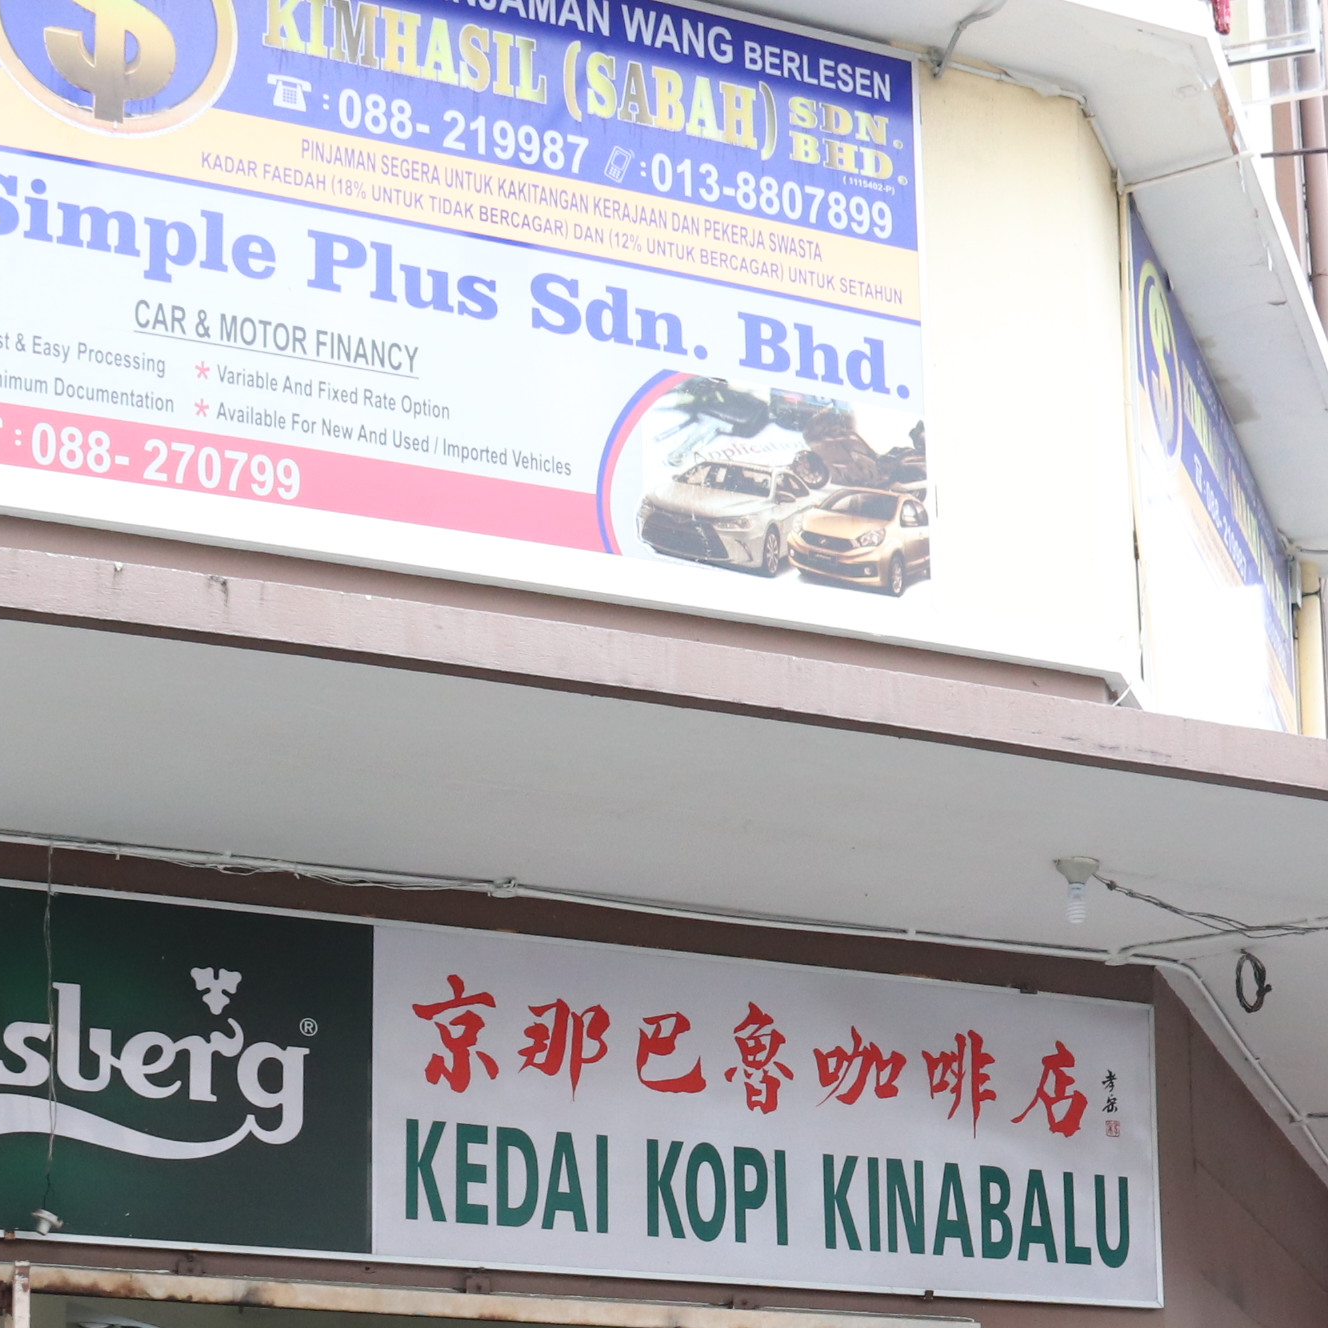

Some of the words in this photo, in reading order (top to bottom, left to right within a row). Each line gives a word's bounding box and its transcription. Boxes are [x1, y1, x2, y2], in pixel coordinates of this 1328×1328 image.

[262, 0, 547, 105] KIMHASIL
[564, 41, 778, 160] (SABAH)
[621, 4, 733, 64] WANG
[745, 40, 891, 103] BERLESEN
[443, 110, 590, 175] 219987
[201, 152, 258, 180] KADAR
[263, 163, 326, 192] FAEDAH
[371, 183, 424, 211] UNTUK
[428, 195, 474, 220] TIDAK
[479, 206, 569, 241] BERCAGAR)
[573, 223, 605, 247] DAN
[647, 237, 695, 264] UNTUK
[700, 249, 784, 284] BERCAGAR)
[788, 265, 835, 291] UNTUK
[840, 277, 902, 306] SETAHUN
[301, 139, 376, 174] PINJAMAN
[380, 155, 441, 188] SEGERA
[444, 168, 494, 197] UNTUK
[497, 176, 590, 213] KAKITANGAN
[594, 195, 669, 232] KERAJAAN
[672, 213, 701, 237] DAN
[704, 218, 765, 251] PEKERJA
[769, 233, 823, 262] SWASTA
[134, 299, 187, 336] CAR
[194, 310, 212, 339] &
[219, 313, 308, 356] MOTOR
[314, 330, 420, 374] FINANCY
[307, 228, 499, 321] Plus
[529, 272, 709, 360] Sdn.
[738, 311, 912, 400] Bhd.
[15, 332, 27, 353] &
[31, 335, 71, 364] Easy
[77, 341, 167, 379] Processing
[216, 364, 280, 392] Variable
[282, 374, 313, 399] And
[318, 381, 359, 406] Fixed
[362, 388, 398, 412] Rate
[400, 394, 450, 421] Option
[54, 378, 175, 413] Documentation
[142, 438, 302, 501] 270799
[216, 402, 287, 431] Available
[290, 413, 318, 436] For
[321, 418, 354, 441] New
[357, 424, 388, 448] And
[392, 429, 430, 455] Used
[442, 437, 508, 468] Imported
[511, 449, 573, 478] Vehicles
[404, 1118, 609, 1234] KEDAI
[647, 1138, 789, 1247] KOPI
[823, 1154, 1131, 1269] KINABALU
